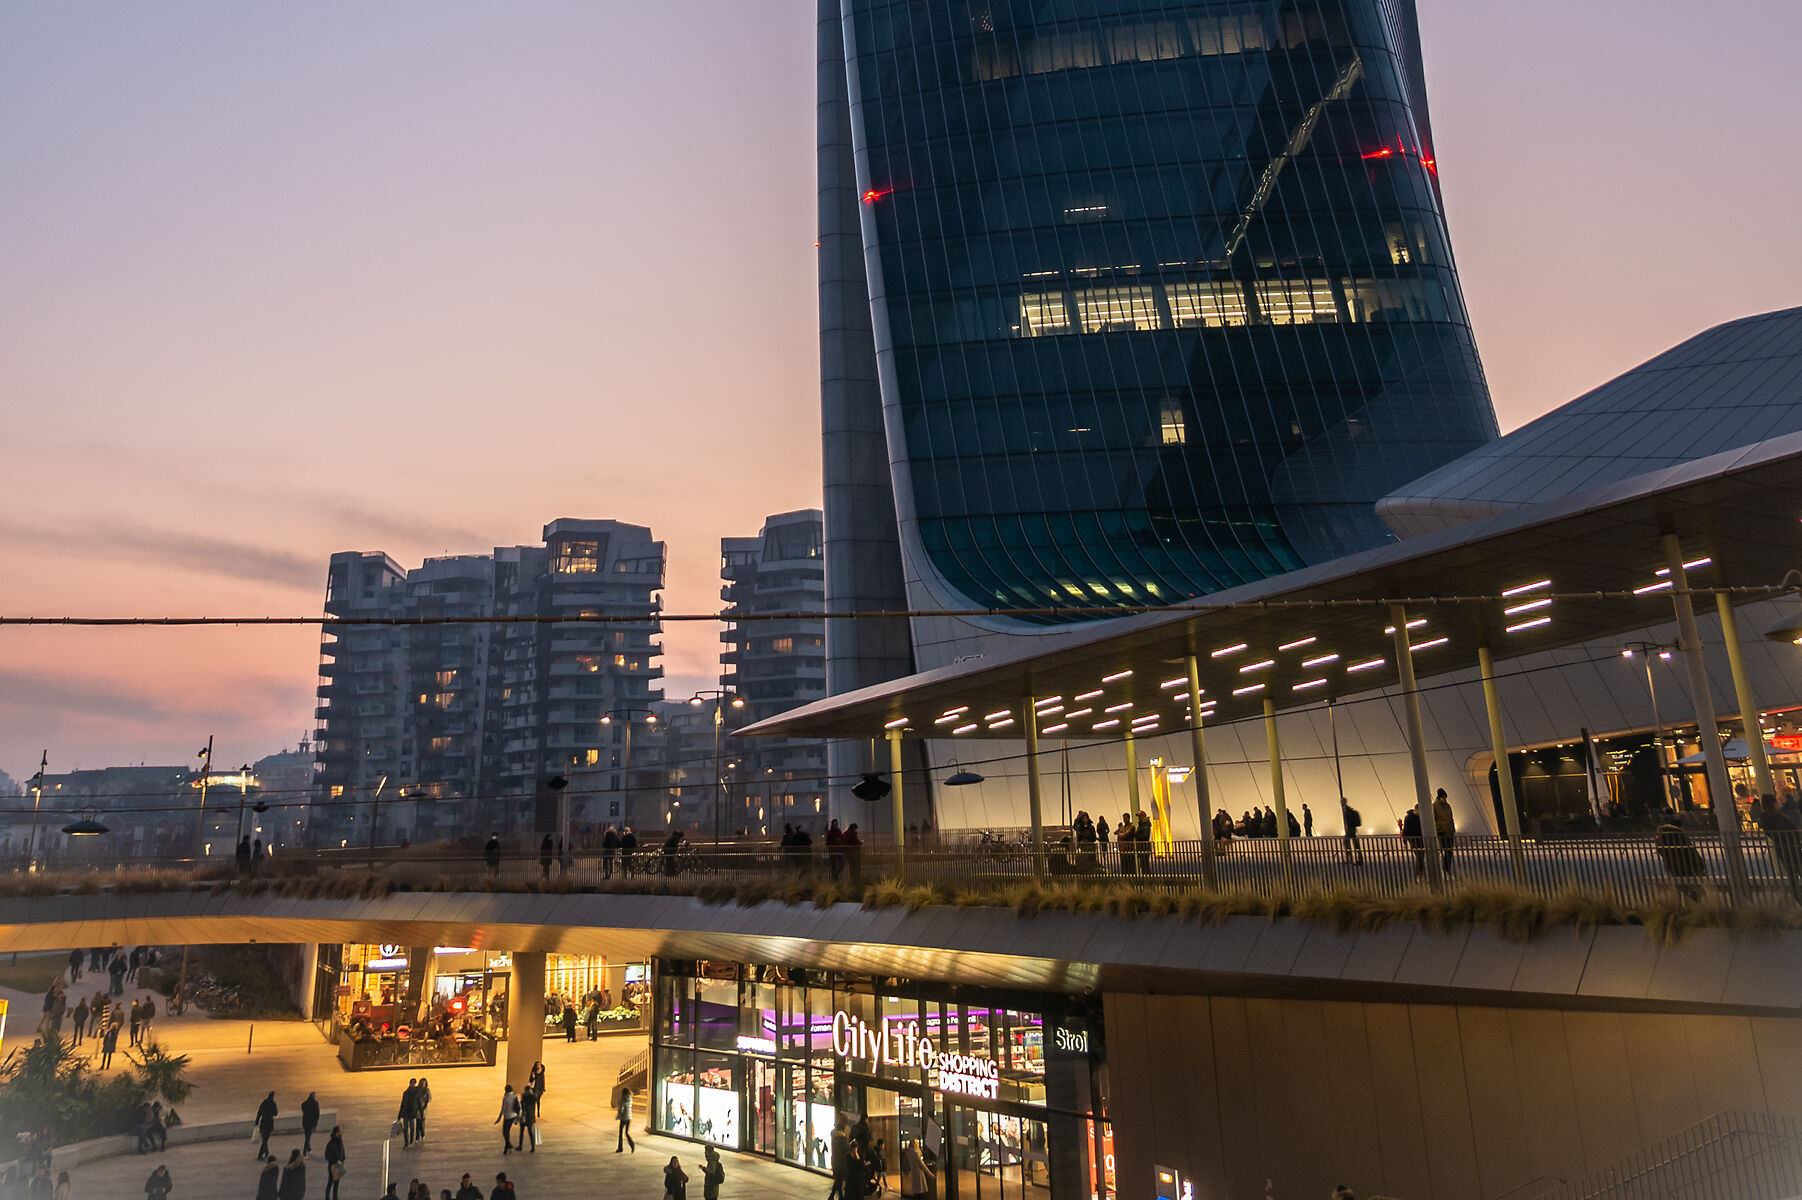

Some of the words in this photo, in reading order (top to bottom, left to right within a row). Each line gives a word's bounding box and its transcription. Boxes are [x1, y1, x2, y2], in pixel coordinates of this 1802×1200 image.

[832, 1010, 933, 1075] CityLife
[938, 1051, 998, 1079] SHOPPING
[939, 1071, 999, 1099] DISTRICT
